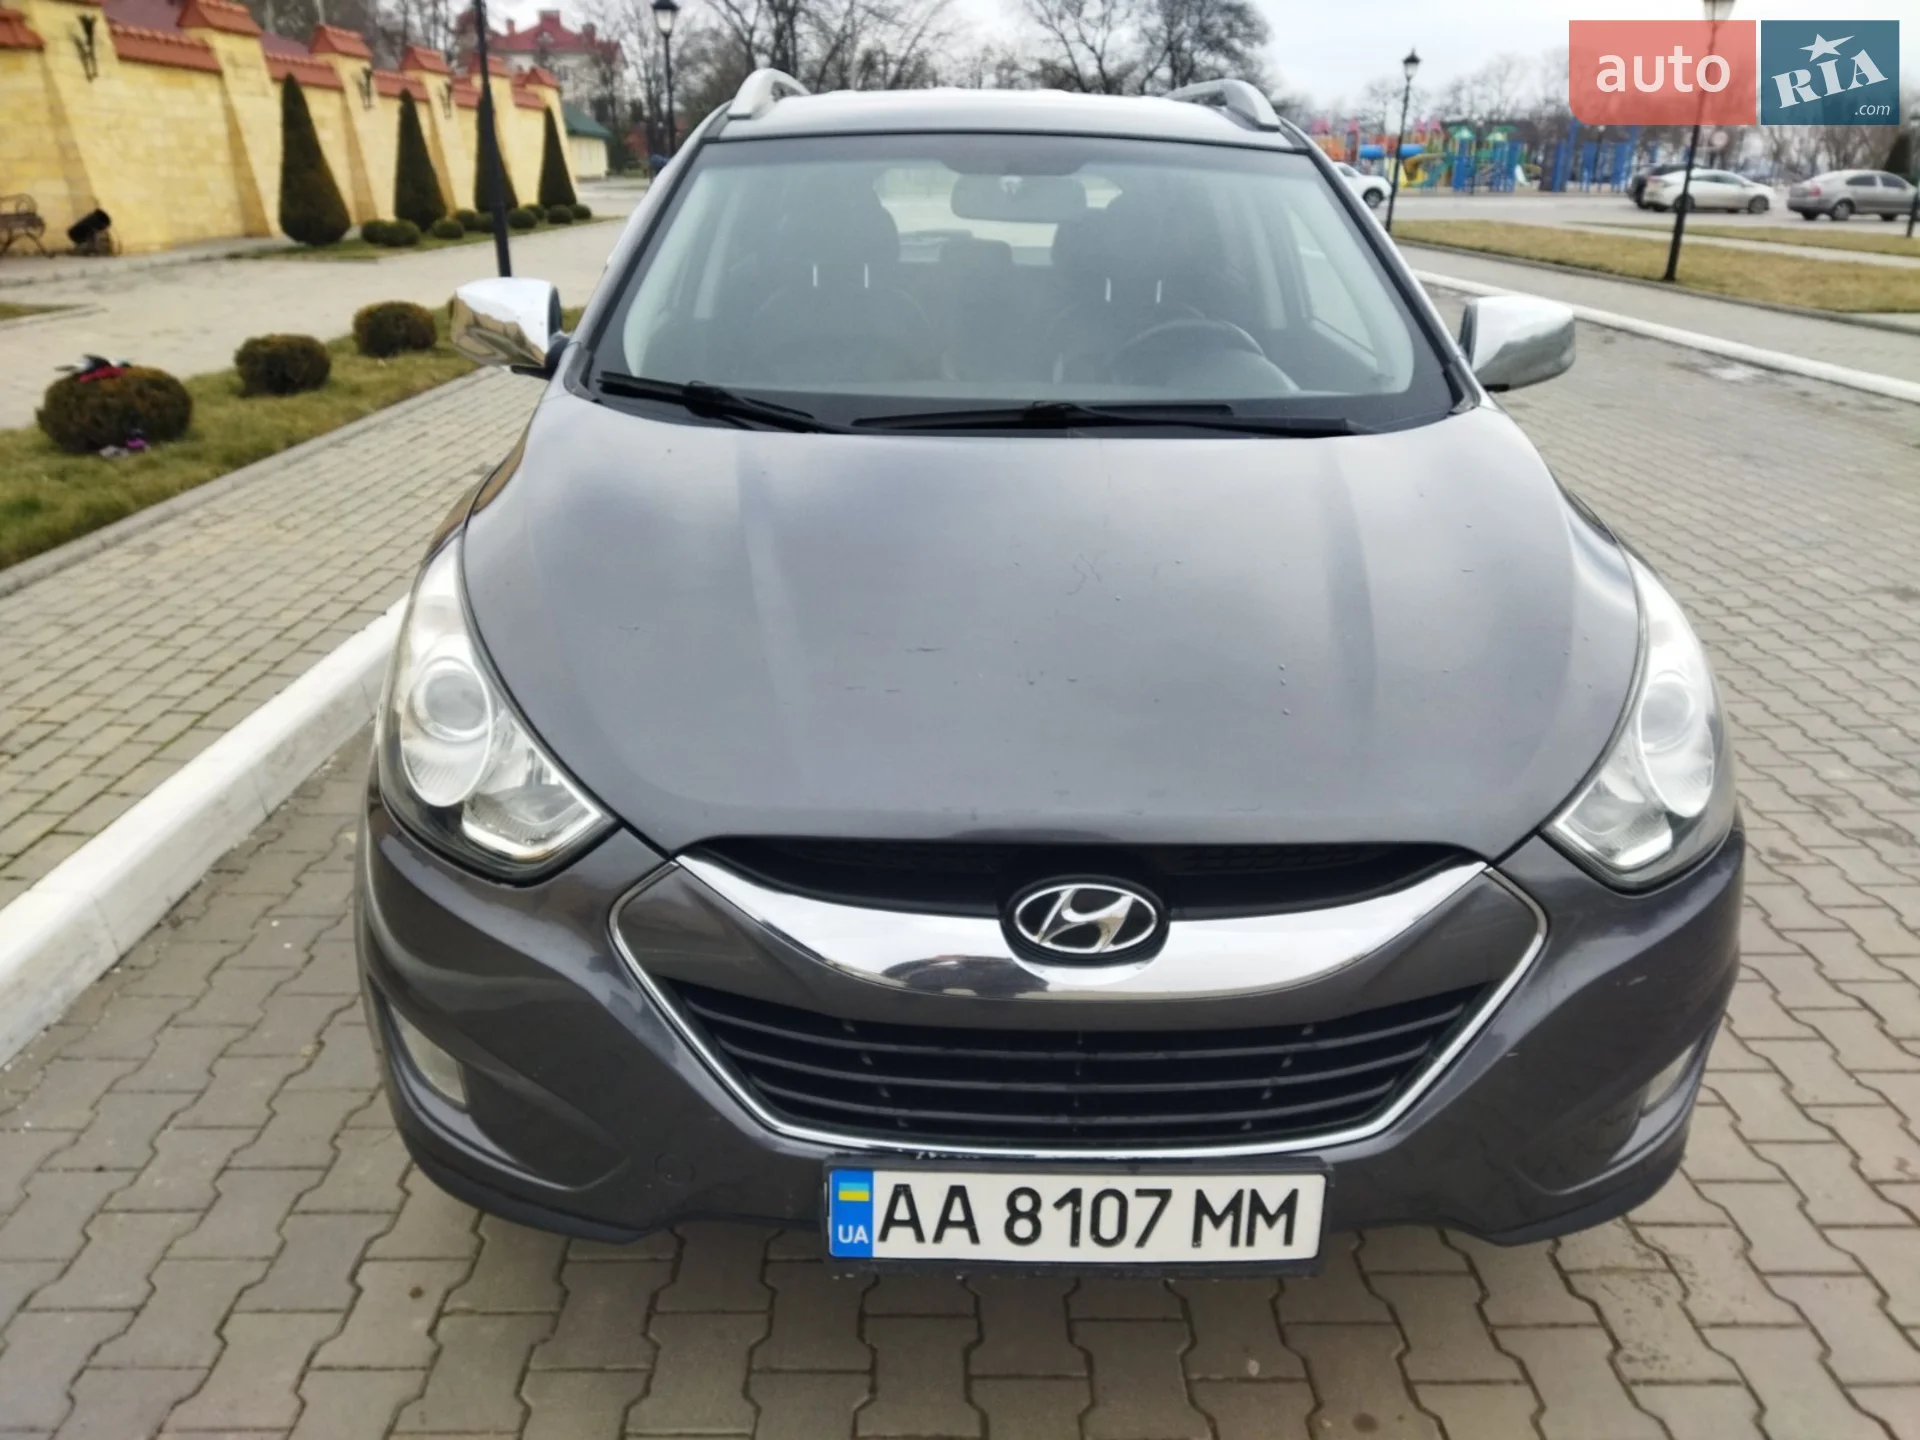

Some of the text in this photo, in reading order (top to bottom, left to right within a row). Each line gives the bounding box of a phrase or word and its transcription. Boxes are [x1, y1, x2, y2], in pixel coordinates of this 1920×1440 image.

[838, 1226, 869, 1244] UA
[878, 1183, 1299, 1248] AA 8107 MM
